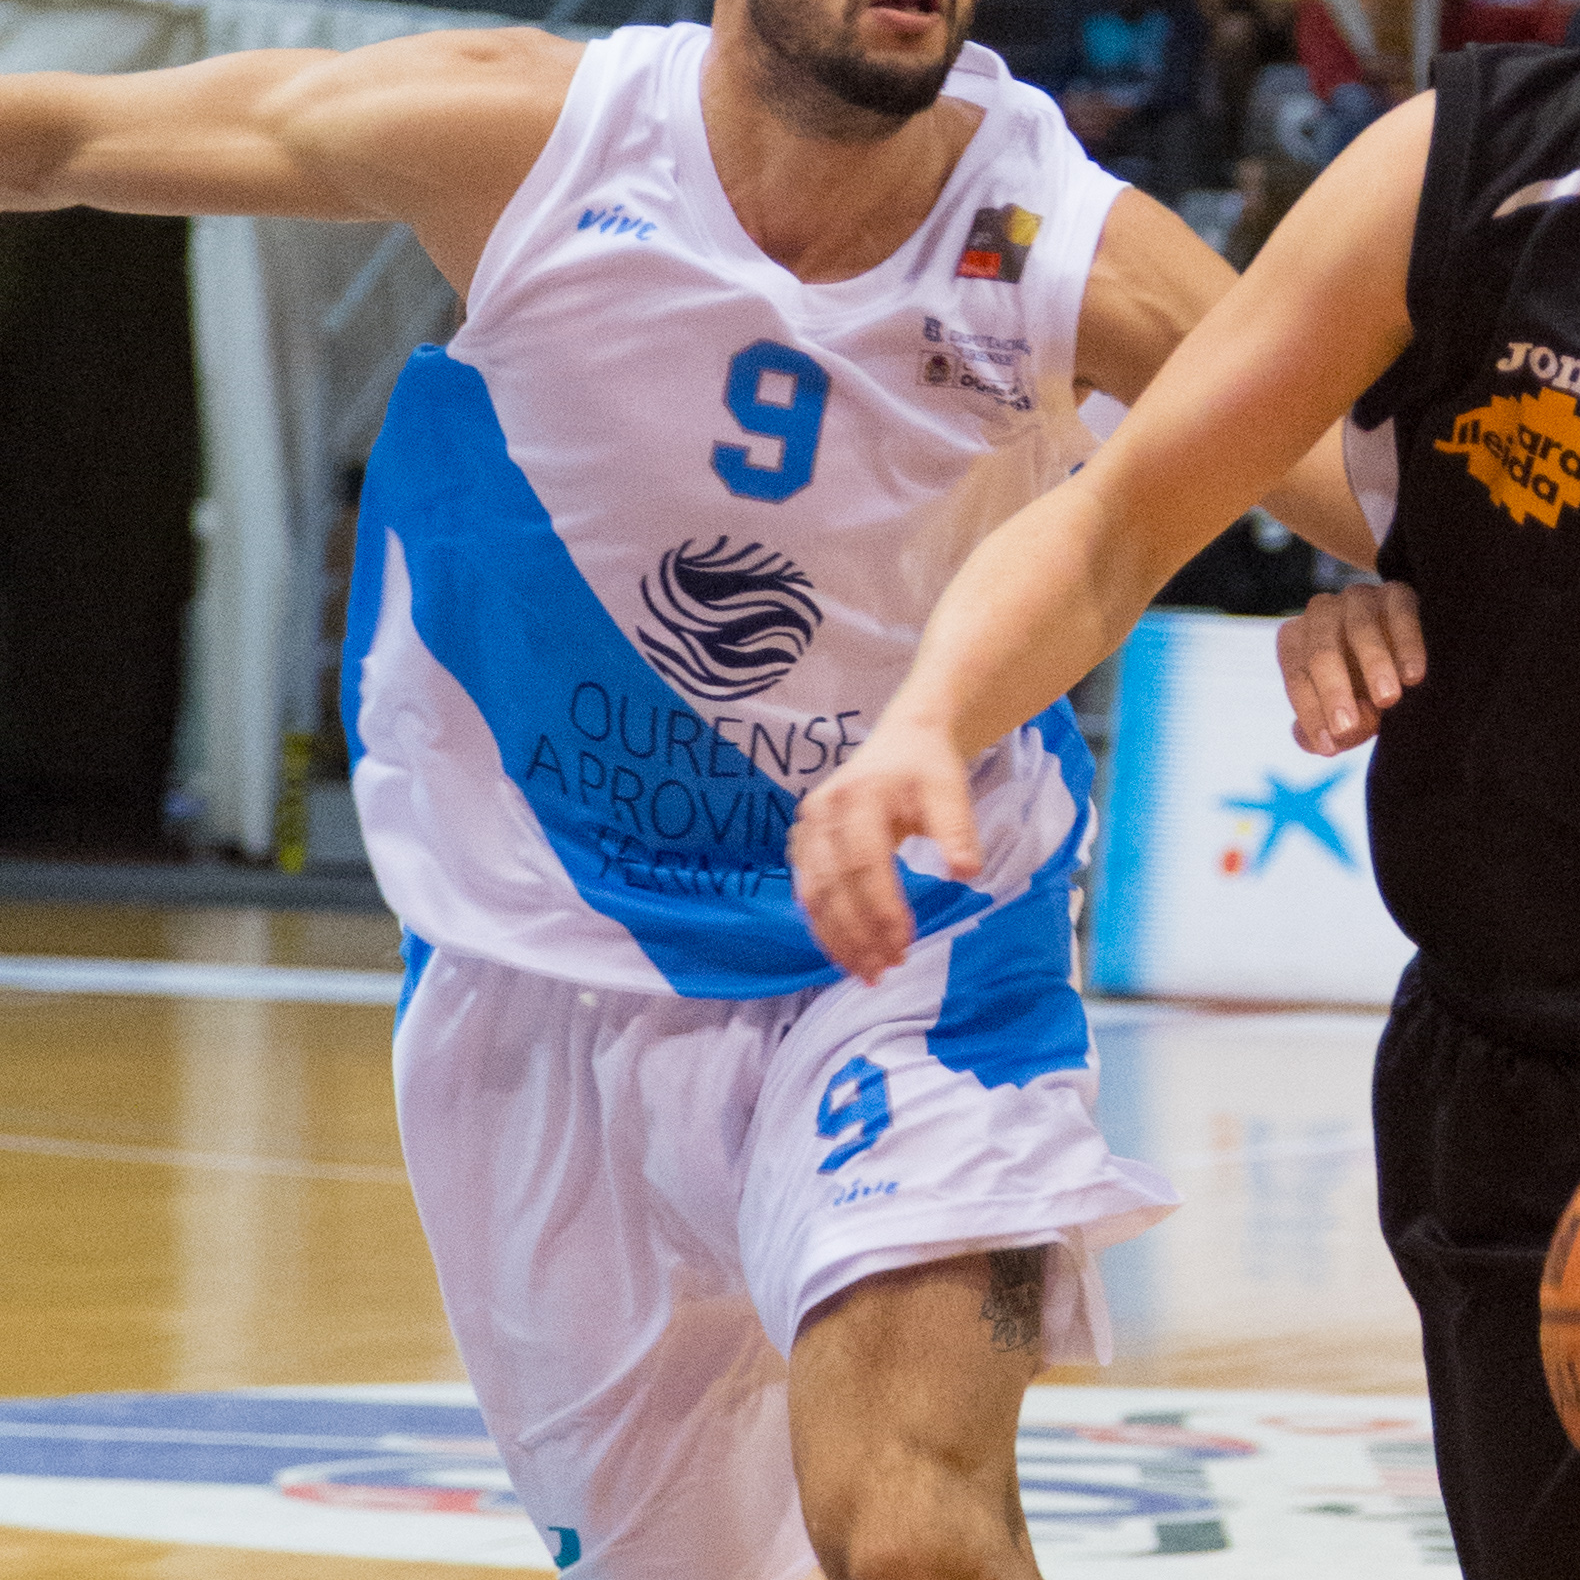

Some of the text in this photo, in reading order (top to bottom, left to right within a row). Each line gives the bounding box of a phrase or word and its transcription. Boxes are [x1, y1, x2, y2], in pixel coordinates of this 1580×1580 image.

[711, 338, 832, 504] 9
[1458, 419, 1560, 505] lleida
[570, 680, 862, 778] OURENSE
[815, 1053, 893, 1176] 9
